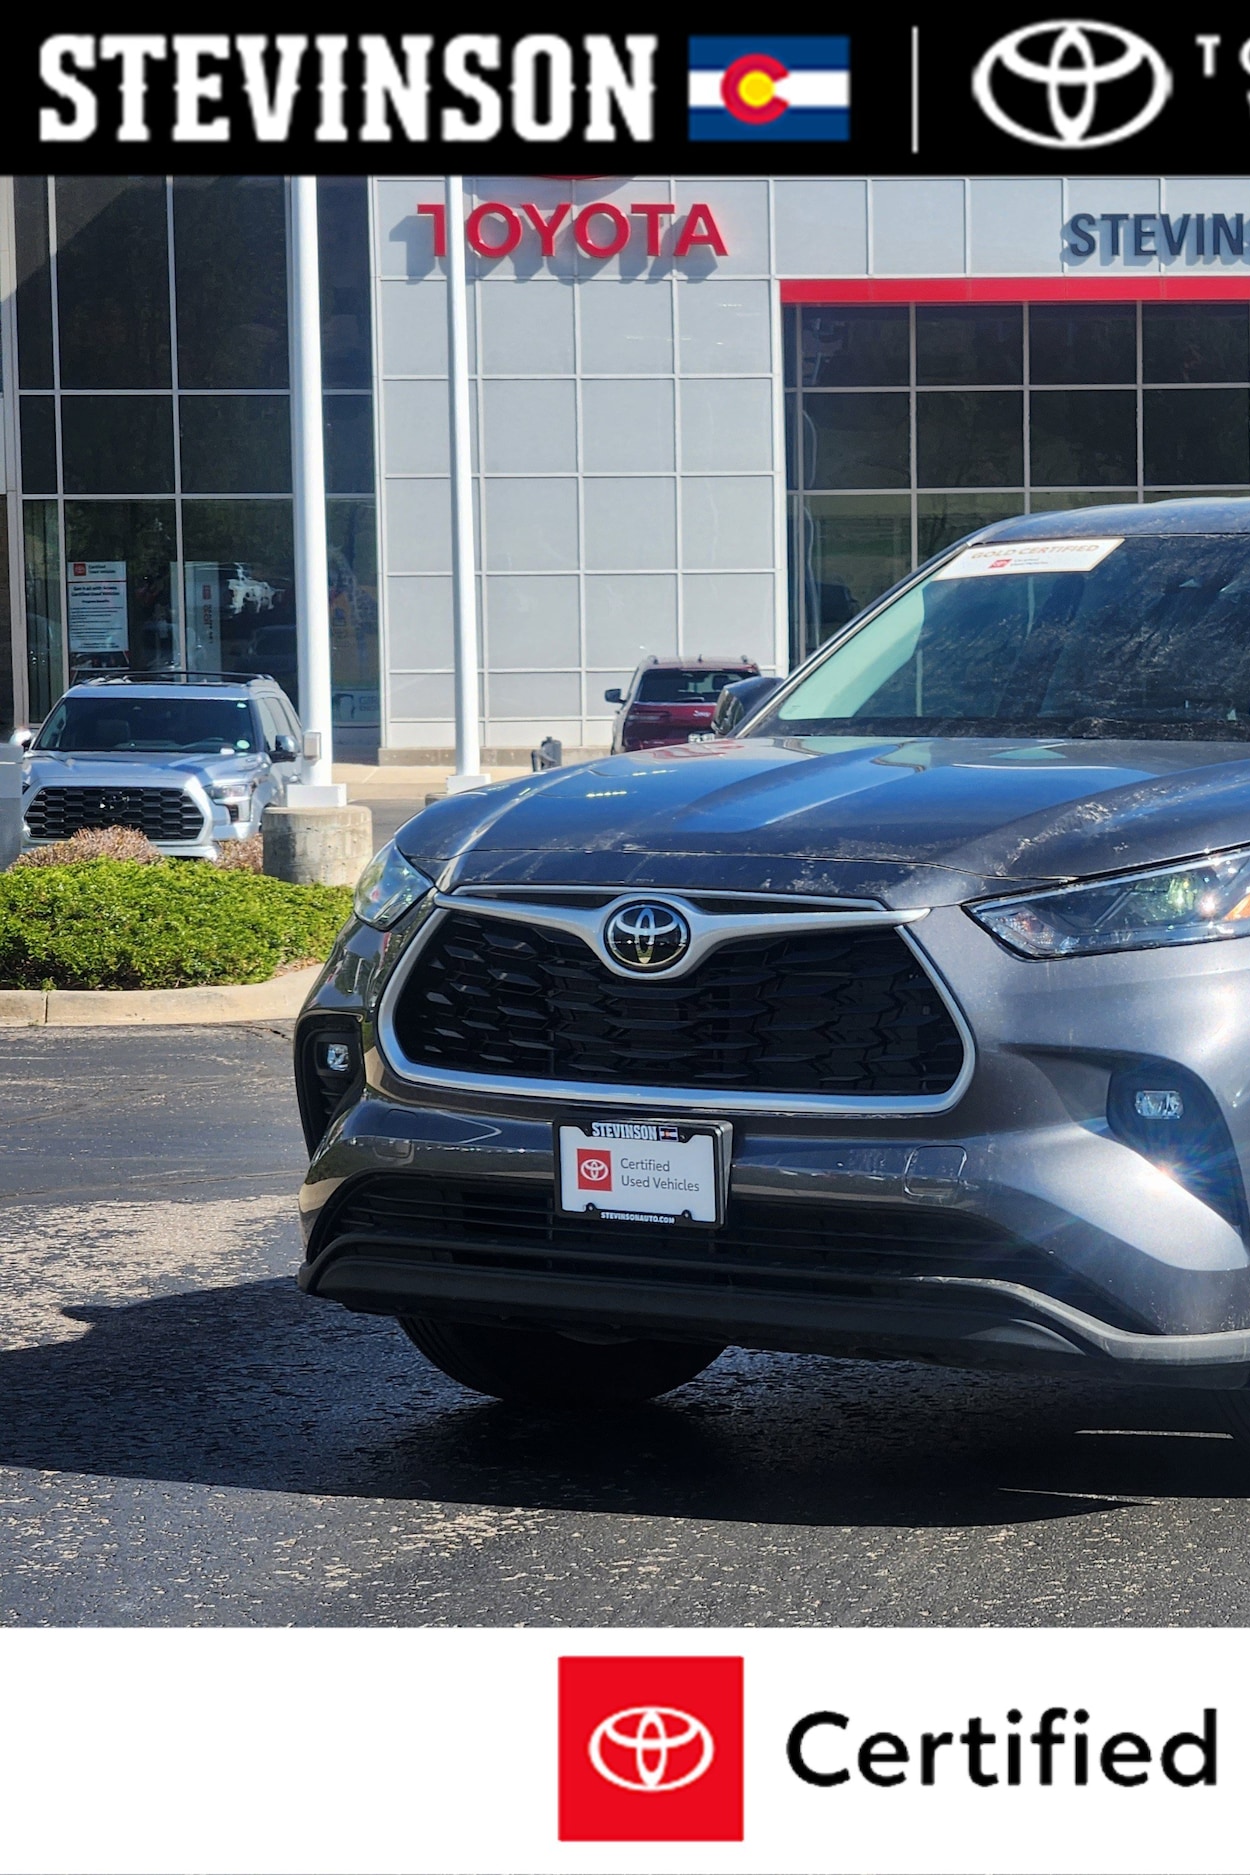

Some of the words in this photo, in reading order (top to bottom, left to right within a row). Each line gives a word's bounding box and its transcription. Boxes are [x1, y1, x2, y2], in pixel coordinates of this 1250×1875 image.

[416, 202, 730, 258] TOYOTA
[971, 549, 1017, 559] GOLD
[1018, 544, 1099, 555] CERTIFIED
[591, 1122, 658, 1142] STEVINSON
[620, 1158, 670, 1172] Certified
[621, 1175, 650, 1188] Used
[653, 1177, 700, 1192] Vehicles
[600, 1211, 676, 1225] STEVINSONAUTO.COM
